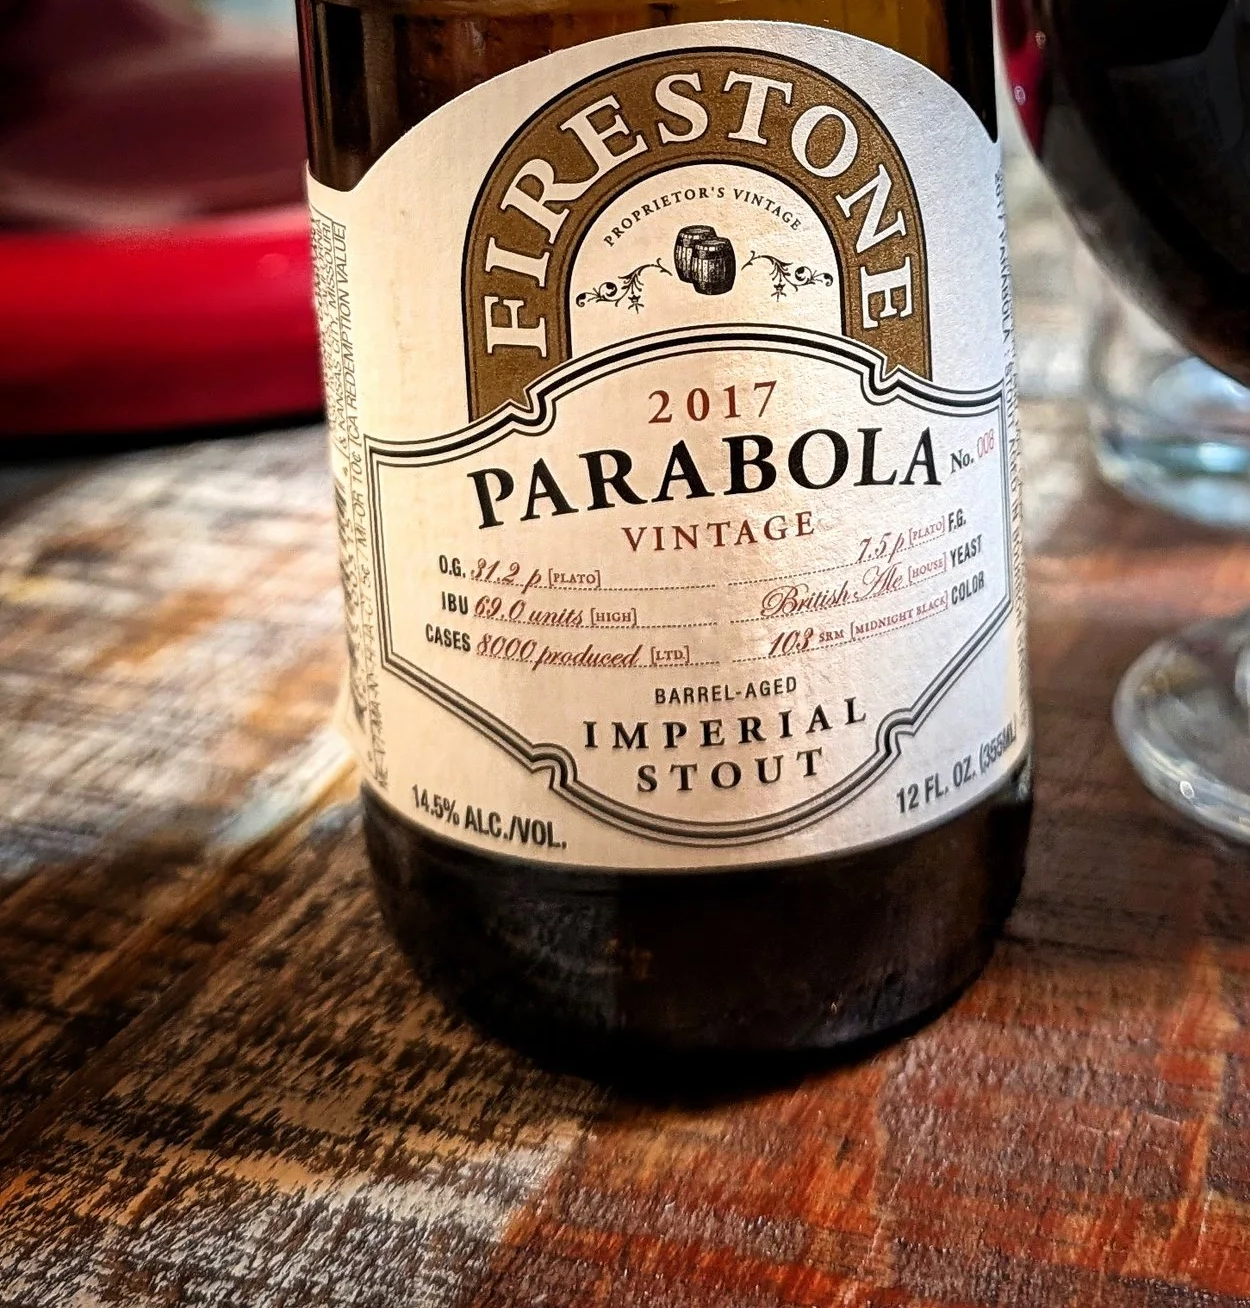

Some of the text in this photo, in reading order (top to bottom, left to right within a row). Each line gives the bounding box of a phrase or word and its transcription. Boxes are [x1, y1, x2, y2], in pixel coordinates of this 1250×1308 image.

[484, 70, 913, 359] FIRESTONE
[603, 187, 802, 247] PROPRIETOR'S VINTAGE
[322, 222, 336, 309] MISSOURI
[339, 288, 357, 410] REDEMPTION
[648, 380, 778, 424] 2017
[466, 426, 942, 530] PARABOLA
[950, 449, 974, 474] No.
[621, 511, 815, 553] VINTAGE
[439, 555, 466, 579] O.G.
[470, 557, 520, 582] 31.2
[548, 568, 601, 588] [PLATO]
[761, 581, 850, 617] British
[854, 562, 903, 599] Ale
[950, 534, 983, 568] YEAST
[441, 591, 637, 626] IBU 69.0 units [HIGH]
[767, 627, 814, 656] 103
[818, 629, 845, 643] SRM
[951, 570, 985, 605] COLOR
[425, 624, 471, 652] CASES
[476, 633, 537, 661] 8000
[532, 644, 643, 671] produced
[655, 676, 797, 706] BARREL-AGED
[584, 695, 867, 750] IMPERIAL
[637, 748, 824, 794] STOUT
[896, 784, 919, 813] 12
[925, 773, 949, 803] FL.
[953, 755, 976, 787] OZ.
[411, 784, 568, 849] 14.5% ALC./VOL.
